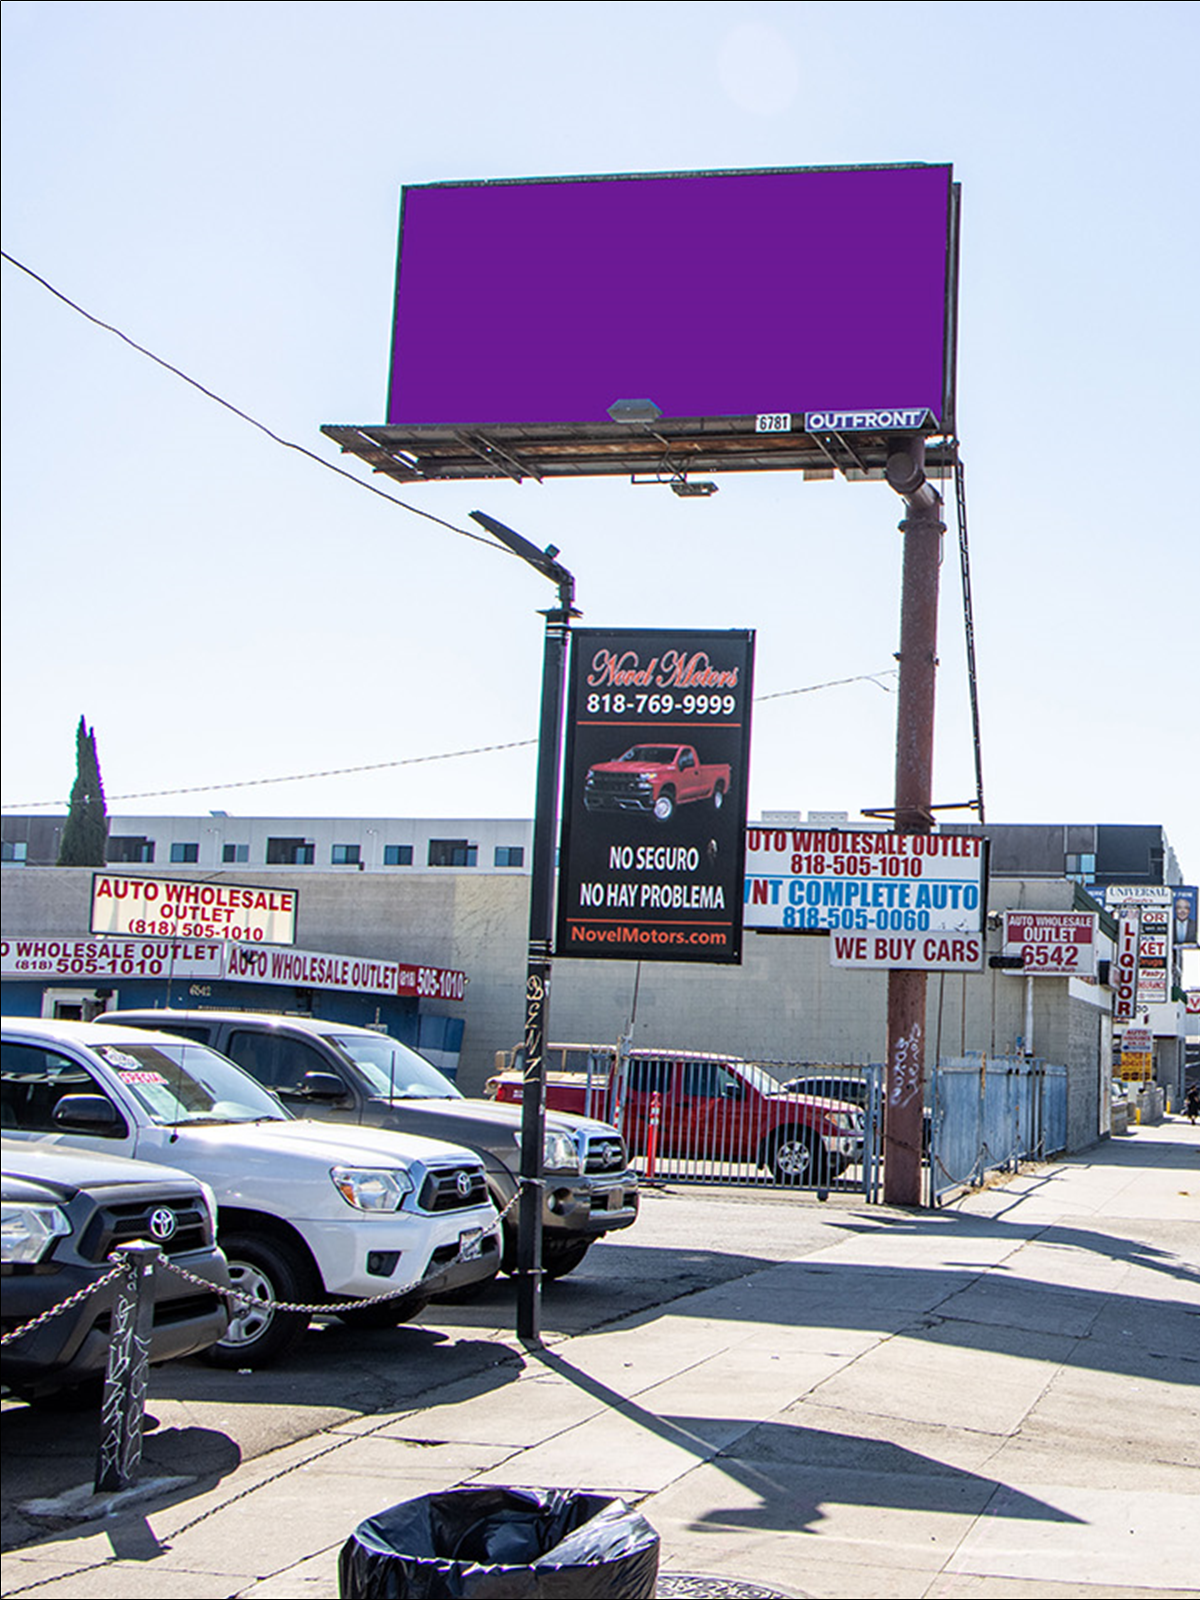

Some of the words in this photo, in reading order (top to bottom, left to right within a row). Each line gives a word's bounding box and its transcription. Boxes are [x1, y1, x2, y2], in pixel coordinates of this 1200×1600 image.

[759, 416, 788, 430] 6781
[809, 411, 920, 429] OUTFRONT
[587, 650, 658, 688] Novel
[655, 650, 739, 689] Motors
[587, 694, 735, 715] 818-769-9999
[748, 830, 787, 852] UTO
[792, 831, 907, 856] WHOLESALE
[912, 836, 982, 858] OUTLET
[609, 846, 633, 870] NO
[636, 847, 699, 872] SEGURO
[791, 854, 922, 877] 818-505-1010
[97, 879, 159, 900] AUTO
[165, 884, 293, 912] WHOLESALE
[580, 883, 605, 907] NO
[607, 884, 638, 908] HAY
[641, 885, 725, 909] PROBLEMA
[789, 880, 910, 908] COMPLETE
[915, 884, 979, 910] AUTO
[1110, 887, 1168, 897] UNIVERSAL
[160, 904, 235, 923] OUTLET
[783, 906, 930, 931] 818-505-0060
[1009, 915, 1034, 926] AUTO
[1035, 916, 1092, 927] WHOLESALE
[128, 919, 176, 936] (818)
[182, 923, 264, 941] 505-1010
[571, 926, 727, 945] NovelMotors.com
[1024, 927, 1076, 942] OUTLET
[16, 943, 135, 959] WHOLESALE
[141, 944, 219, 960] OUTLET
[835, 937, 867, 960] WE
[875, 938, 916, 961] BUY
[923, 939, 979, 962] CARS
[1021, 945, 1079, 966] 6542
[15, 960, 53, 970] (818)
[56, 959, 163, 975] 505-1010
[272, 953, 349, 985] WHOLESALE
[352, 962, 398, 989] OUTLET
[1117, 922, 1135, 1016] LIQUOR
[417, 967, 464, 998] 505-1010
